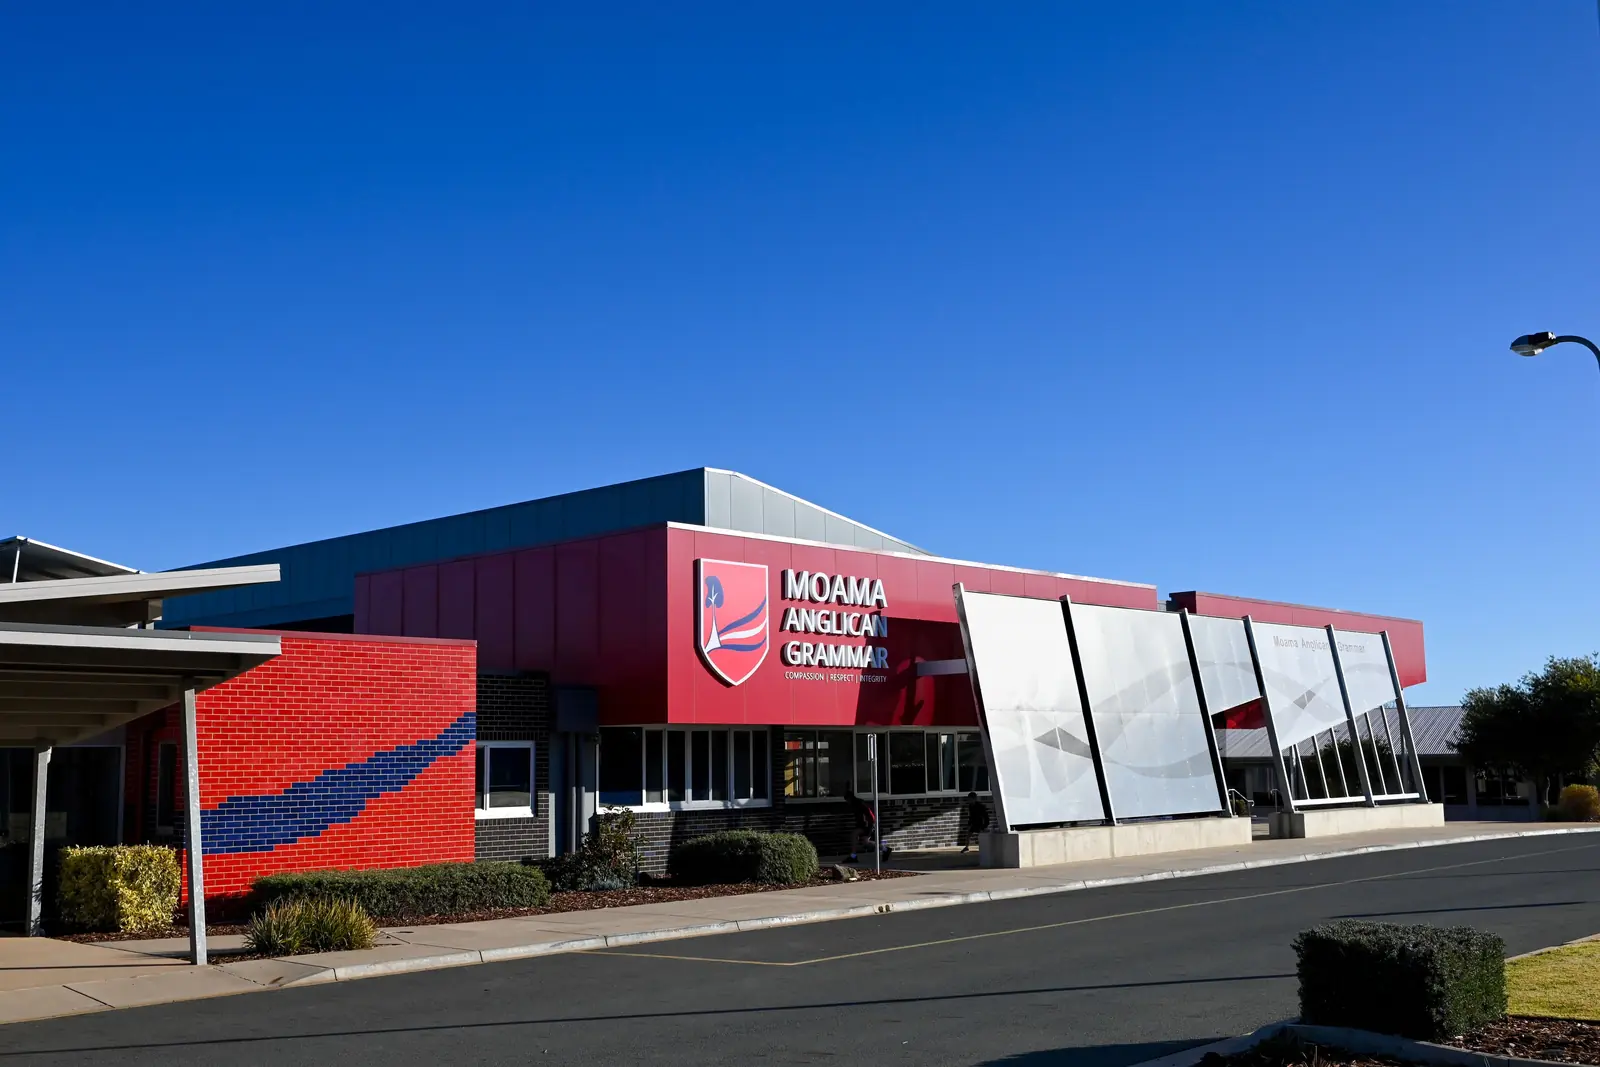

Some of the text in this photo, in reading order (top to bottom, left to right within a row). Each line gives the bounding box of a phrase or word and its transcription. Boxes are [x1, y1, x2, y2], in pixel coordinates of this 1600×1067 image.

[785, 569, 888, 607] MOAMA
[784, 607, 888, 638] ANGLICAN
[785, 641, 889, 669] GRAMMAR
[1273, 635, 1299, 649] Moama
[784, 671, 887, 683] COMPASSION RESPECT INTEGRITY
